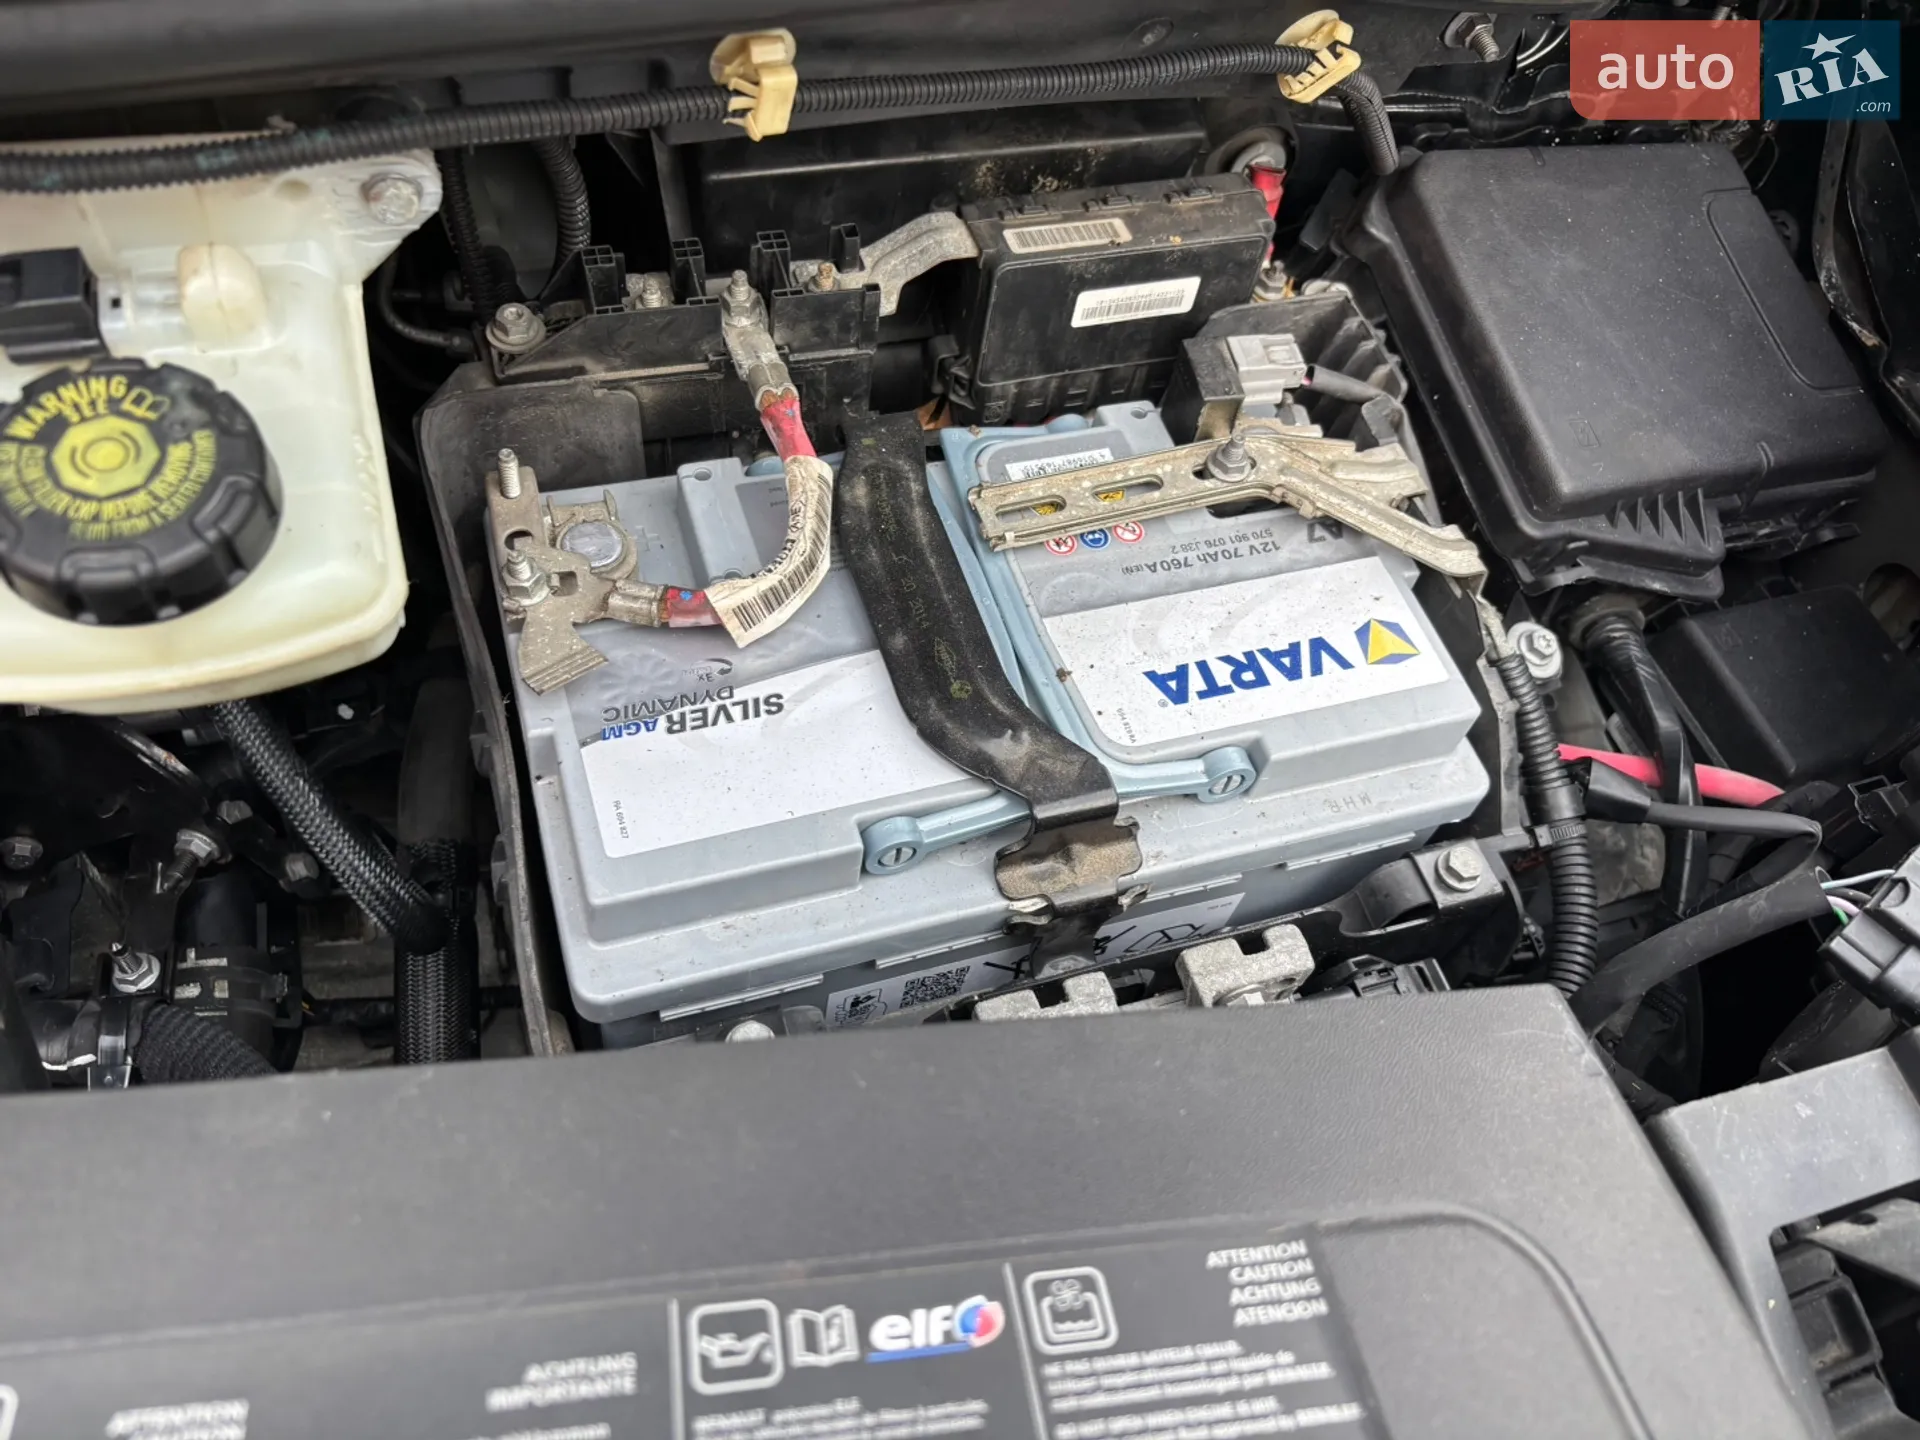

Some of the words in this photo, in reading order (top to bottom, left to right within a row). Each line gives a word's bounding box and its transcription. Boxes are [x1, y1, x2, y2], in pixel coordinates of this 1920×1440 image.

[3, 375, 128, 440] WARNING
[1146, 555, 1195, 573] 760A
[1196, 544, 1243, 565] 70Ah
[1249, 540, 1281, 557] 12V
[1142, 636, 1355, 706] VARTA
[602, 685, 734, 723] DYNAMIC
[666, 693, 785, 735] SILVER
[601, 716, 659, 741] AGM
[1205, 1239, 1308, 1270] ATTENTION
[1228, 1257, 1315, 1285] CAUTION
[1229, 1276, 1322, 1307] ACHTUNG
[868, 1305, 954, 1351] elf
